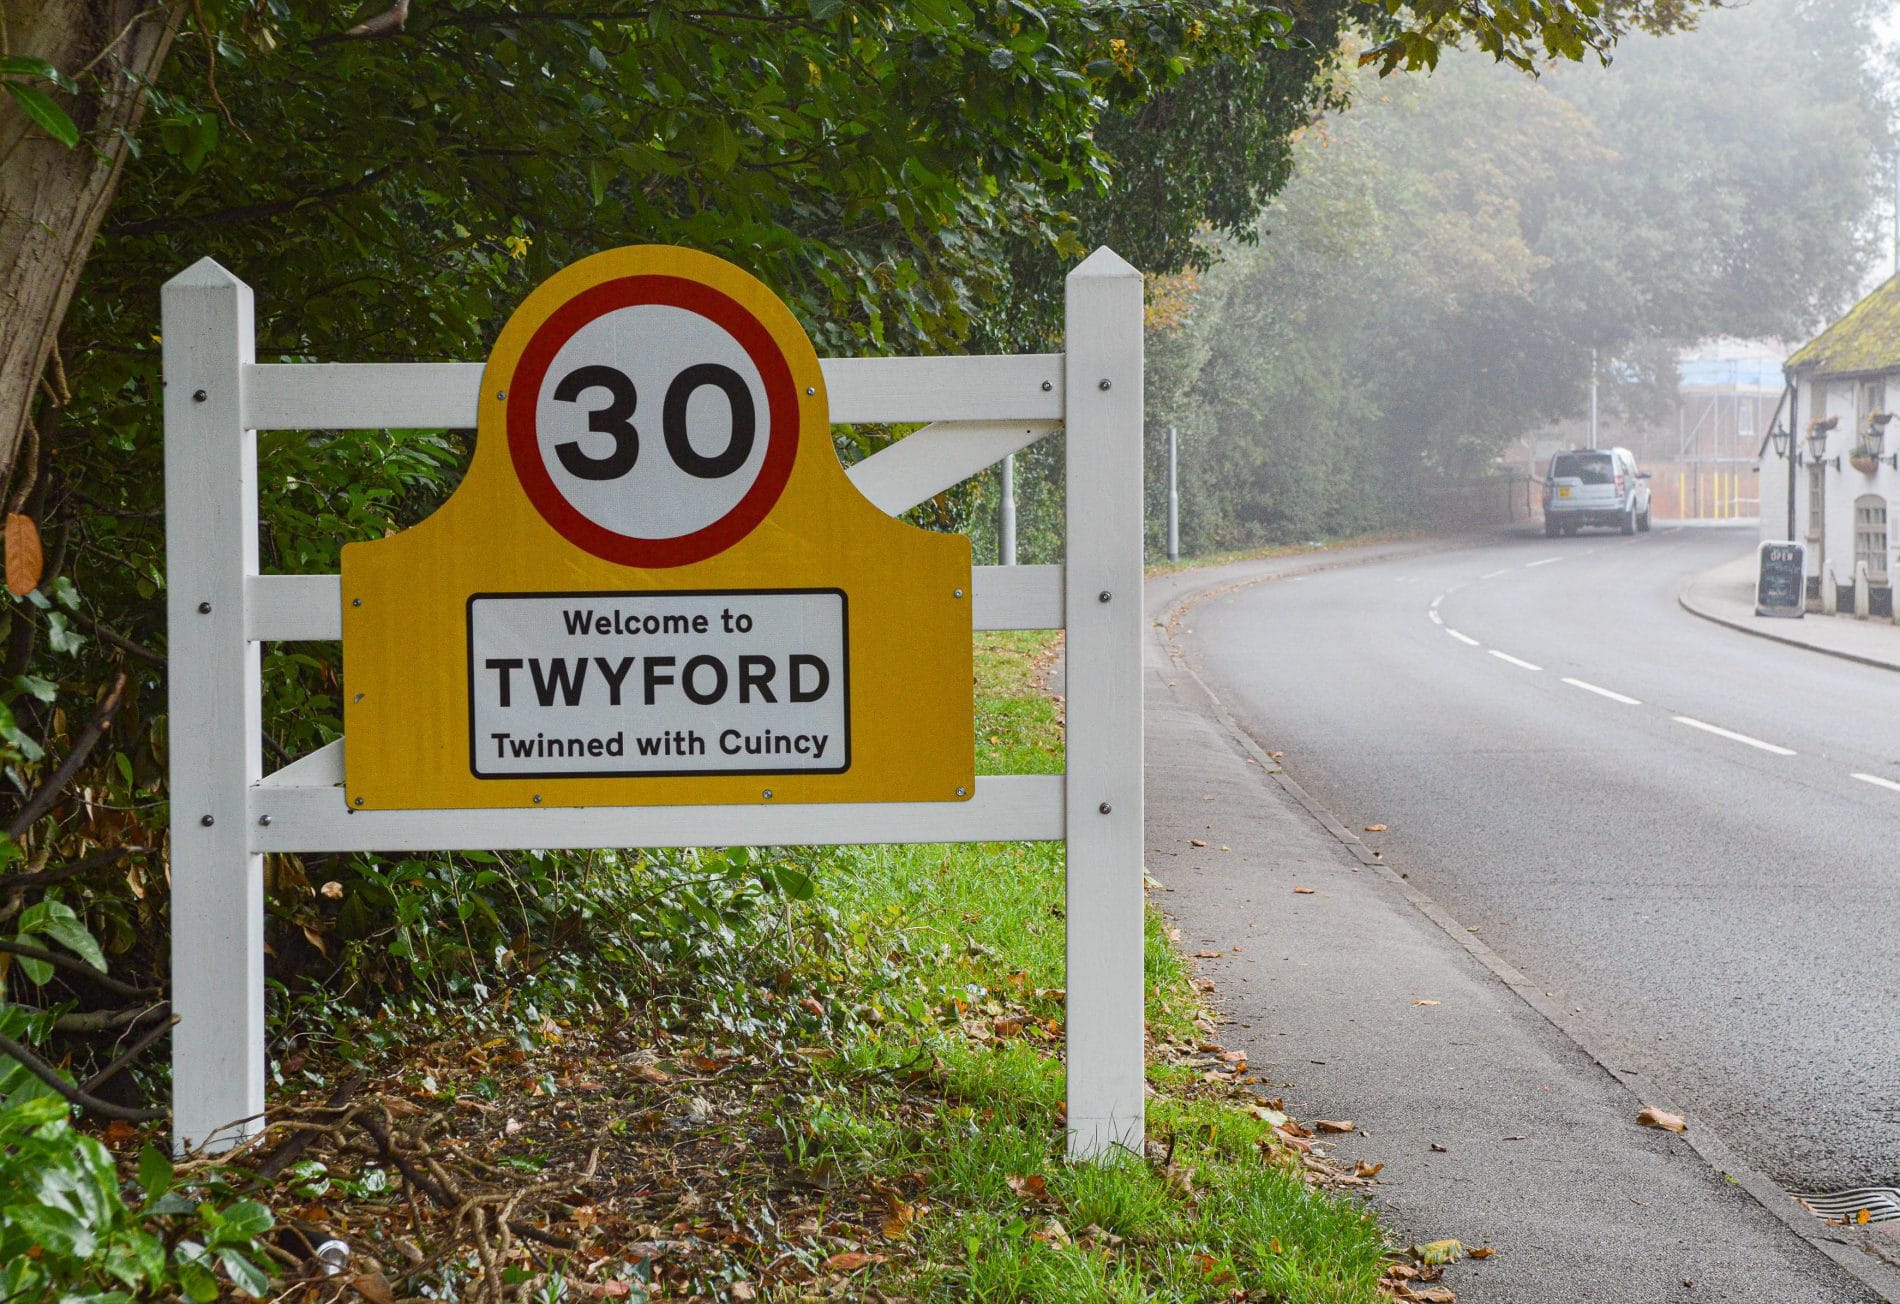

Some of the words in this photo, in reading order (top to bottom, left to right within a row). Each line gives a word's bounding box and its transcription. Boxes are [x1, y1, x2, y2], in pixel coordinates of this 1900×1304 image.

[552, 363, 756, 482] 30
[1770, 551, 1793, 561] OPEN
[562, 609, 709, 636] Welcome
[720, 607, 753, 634] to
[485, 654, 830, 708] TWYFORD
[490, 731, 624, 759] Twinned
[635, 729, 706, 757] with
[719, 728, 829, 759] Cuincy
